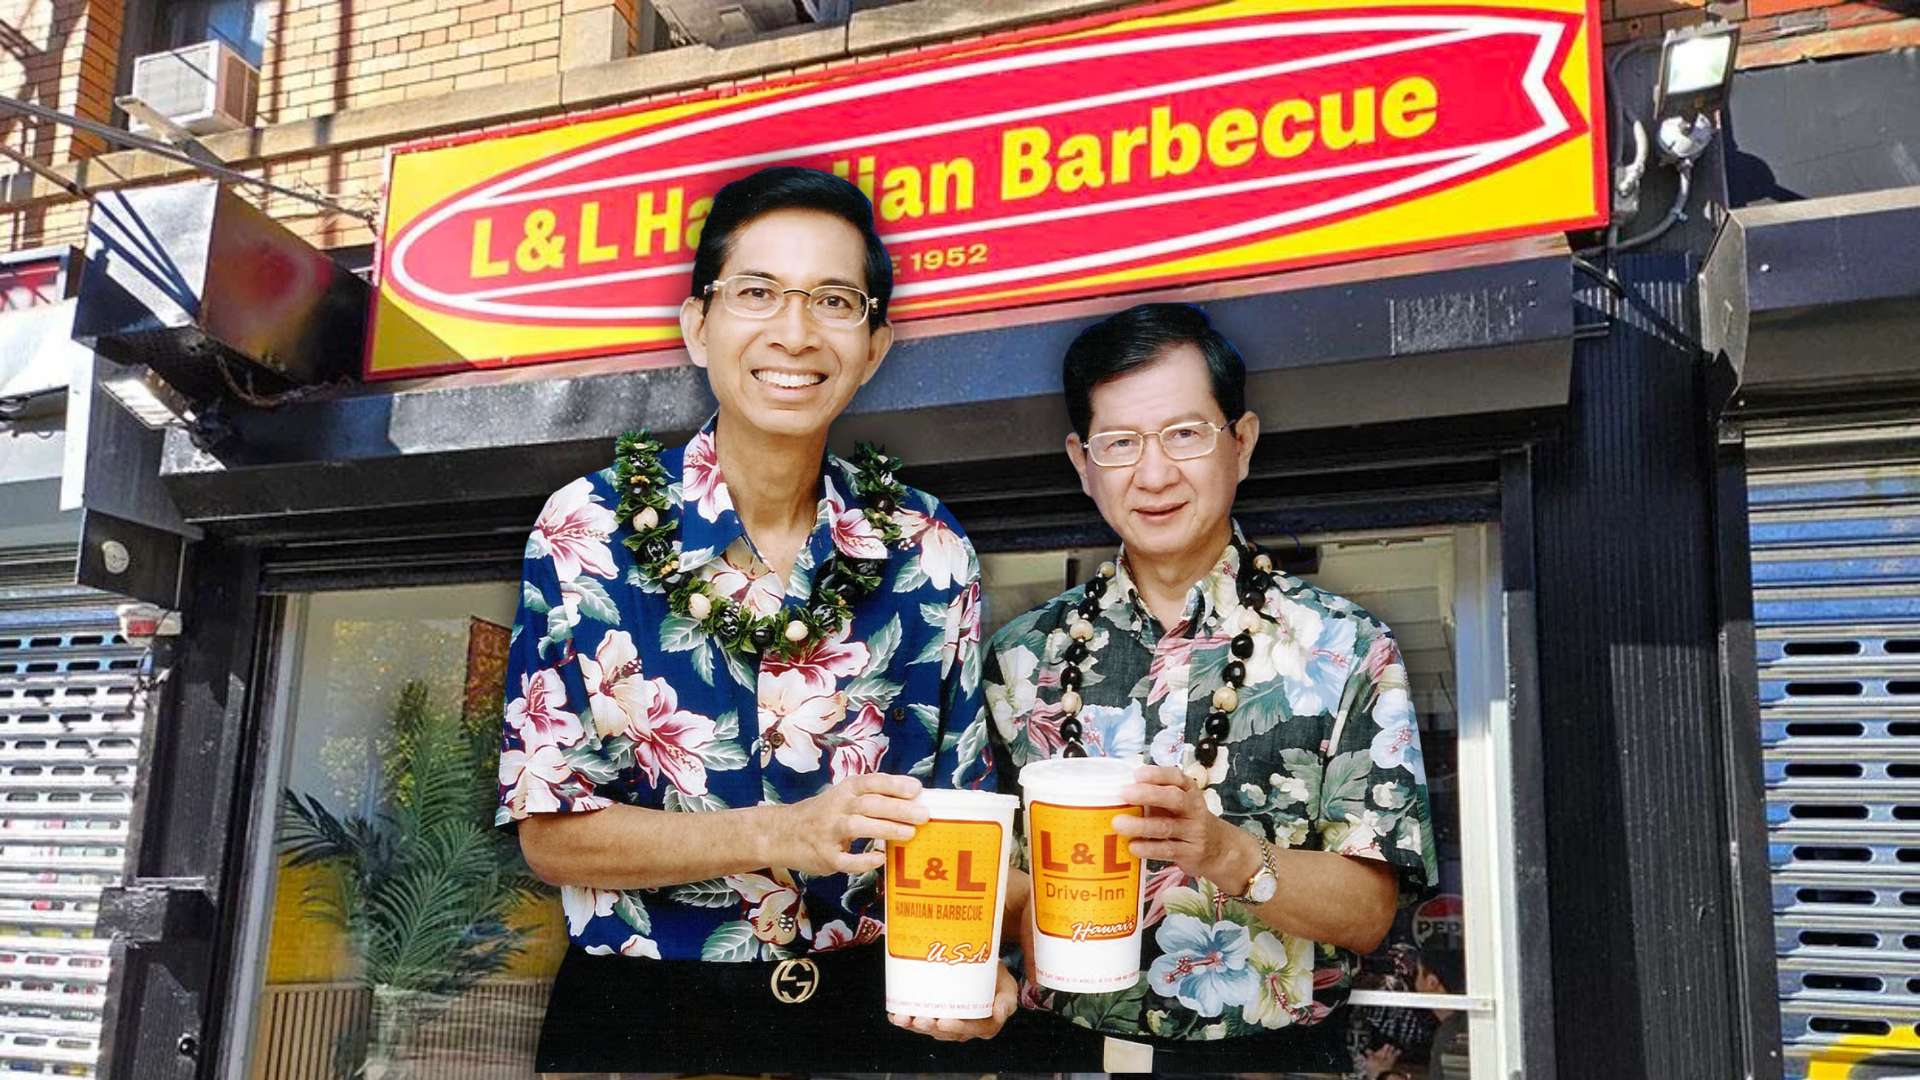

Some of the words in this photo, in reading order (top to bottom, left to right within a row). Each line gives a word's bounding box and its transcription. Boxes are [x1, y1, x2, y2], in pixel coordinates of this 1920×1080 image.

[1000, 75, 1439, 201] Barbecue
[911, 243, 988, 273] 1952
[1046, 882, 1125, 901] Drive-Inn
[895, 901, 933, 919] HAWAIIAN
[936, 904, 983, 920] BARBECUE
